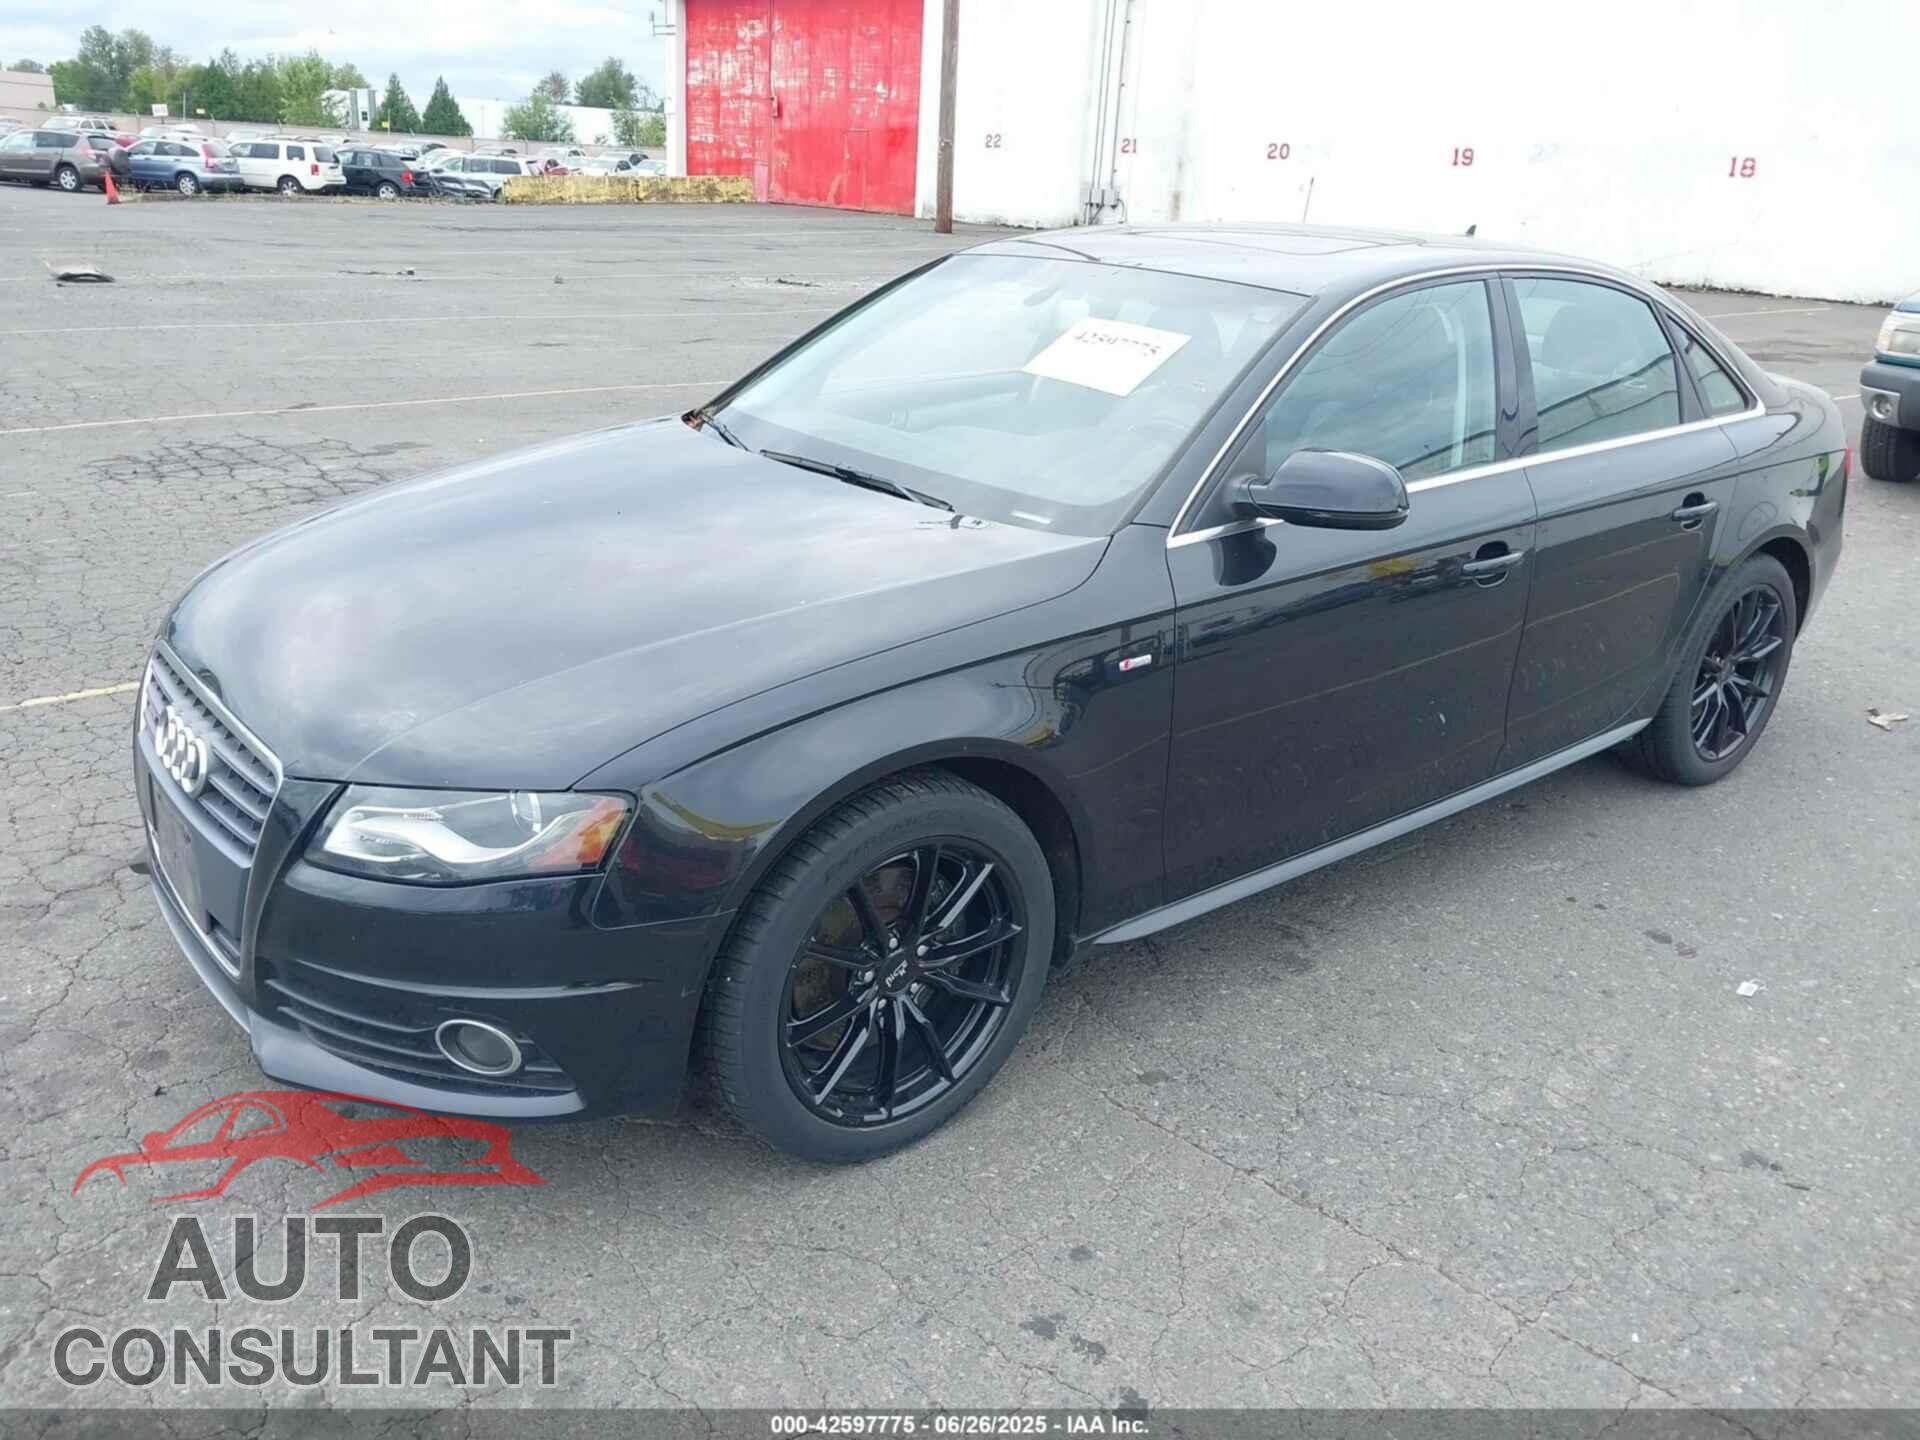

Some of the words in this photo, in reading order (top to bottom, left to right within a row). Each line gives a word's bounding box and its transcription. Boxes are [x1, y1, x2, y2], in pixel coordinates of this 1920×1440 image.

[985, 133, 1001, 149] 22
[1121, 137, 1137, 154] 21
[1267, 143, 1290, 160] 20
[1452, 147, 1474, 167] 19
[1728, 156, 1756, 178] 18
